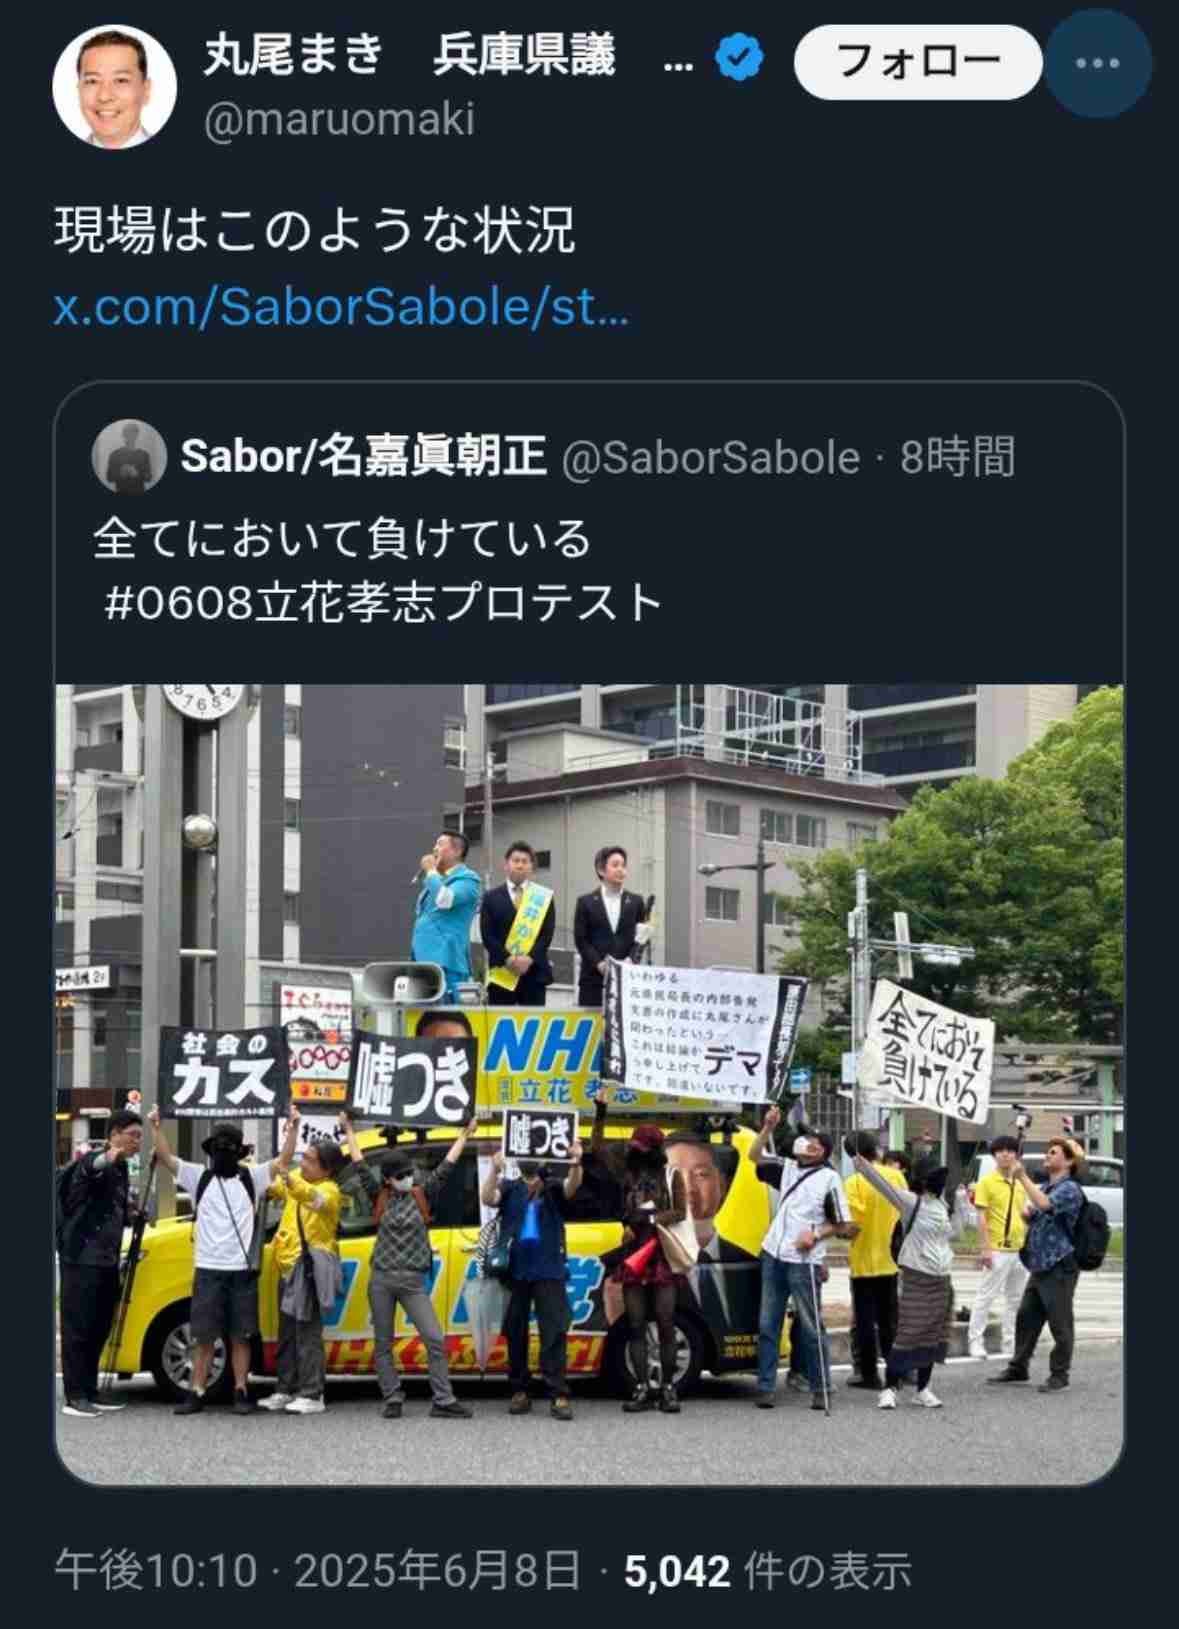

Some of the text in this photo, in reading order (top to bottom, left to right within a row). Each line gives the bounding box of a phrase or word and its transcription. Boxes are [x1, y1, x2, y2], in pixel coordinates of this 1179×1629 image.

[202, 30, 617, 77] 丸尾まき 兵庫県議
[838, 44, 1001, 81] フォロー
[204, 99, 475, 145] @maruomaki
[53, 204, 576, 257] 現場はこのような状況
[181, 431, 1015, 485] Sabor/名嘉眞朝正 @SaborSabole 8時間
[93, 515, 591, 561] 全てにおいて負けている
[104, 579, 661, 625] #0608立花孝志プロテスト
[197, 698, 207, 711] 6
[181, 1032, 268, 1056] 社会の
[484, 1017, 604, 1074] NH
[877, 990, 985, 1072] 全てにおいて
[172, 1057, 276, 1105] カス
[352, 1041, 471, 1123] 嘘つき
[704, 1044, 762, 1077] デマ
[877, 1039, 978, 1121] 負けている
[508, 1113, 571, 1158] 嘘つき
[54, 1547, 913, 1596] 午後10:10 2025年6月8日 5,042 件の表示
